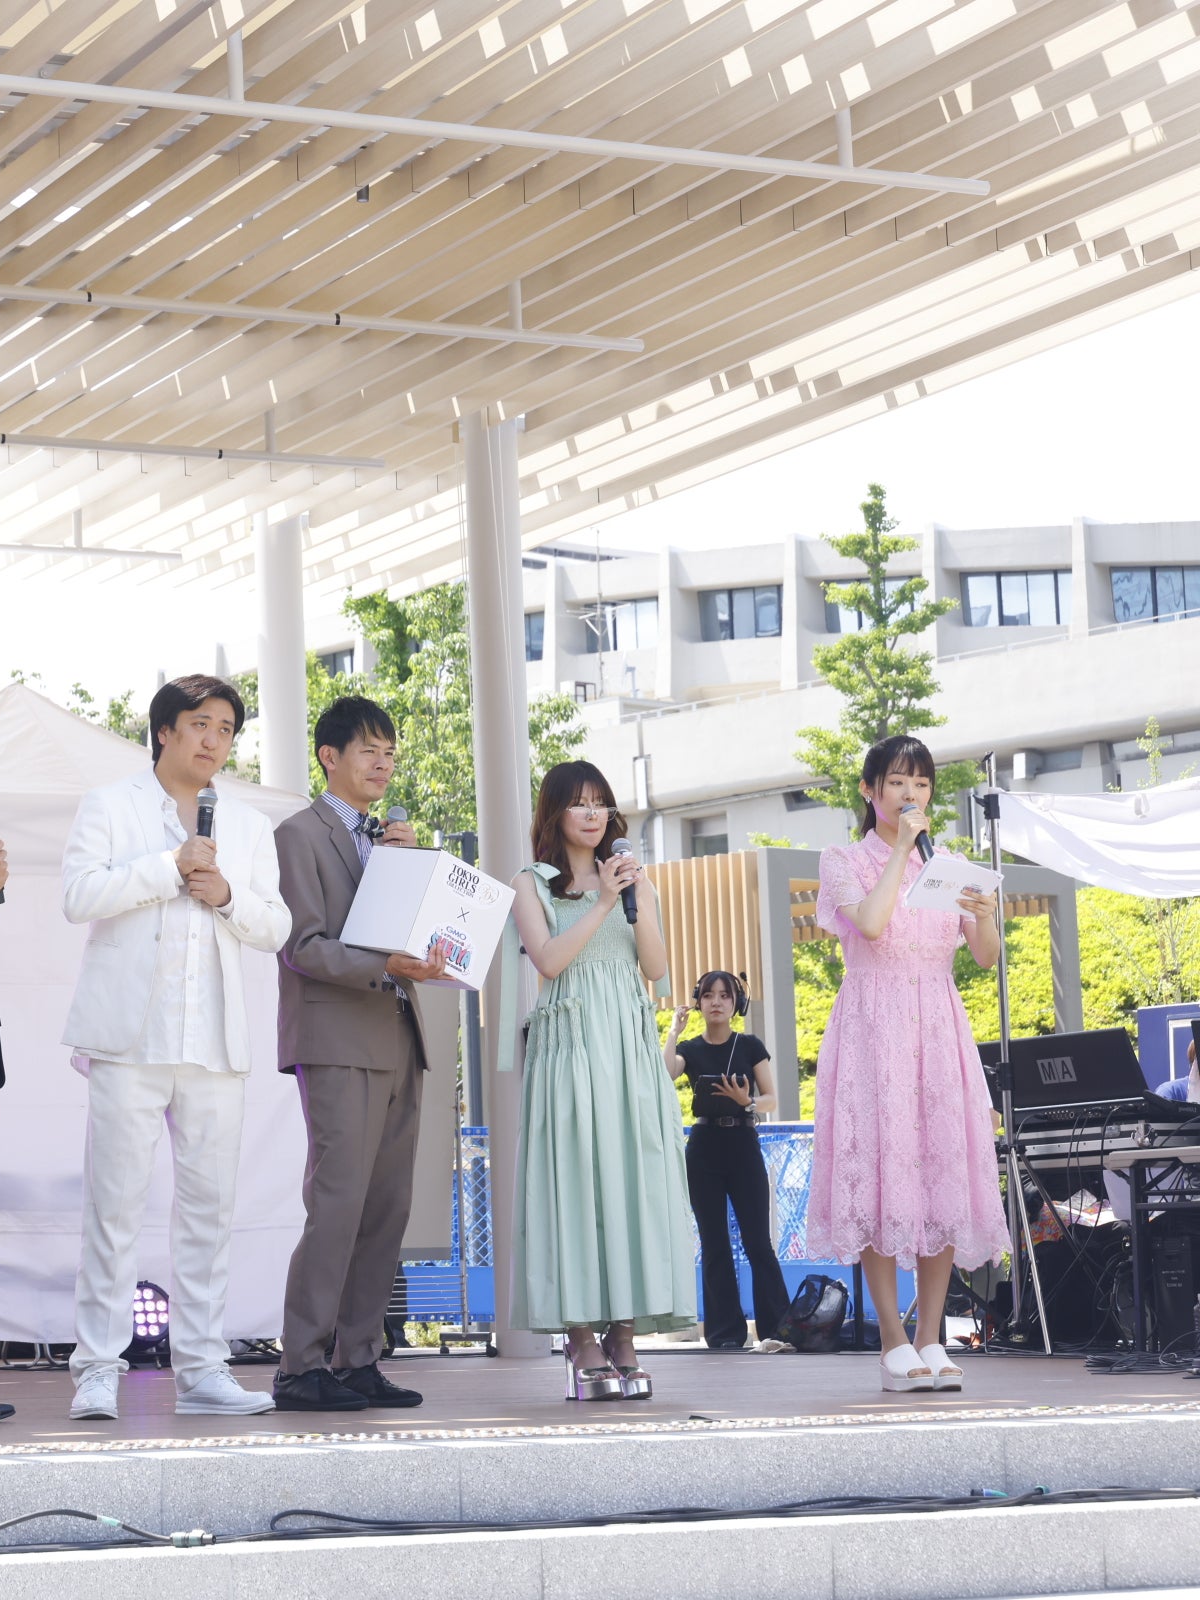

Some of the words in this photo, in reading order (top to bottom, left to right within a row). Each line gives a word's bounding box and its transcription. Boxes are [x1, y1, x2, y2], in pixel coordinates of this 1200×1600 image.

[448, 872, 477, 894] GIRLS
[452, 863, 480, 885] TOKYO
[446, 925, 467, 941] GMO
